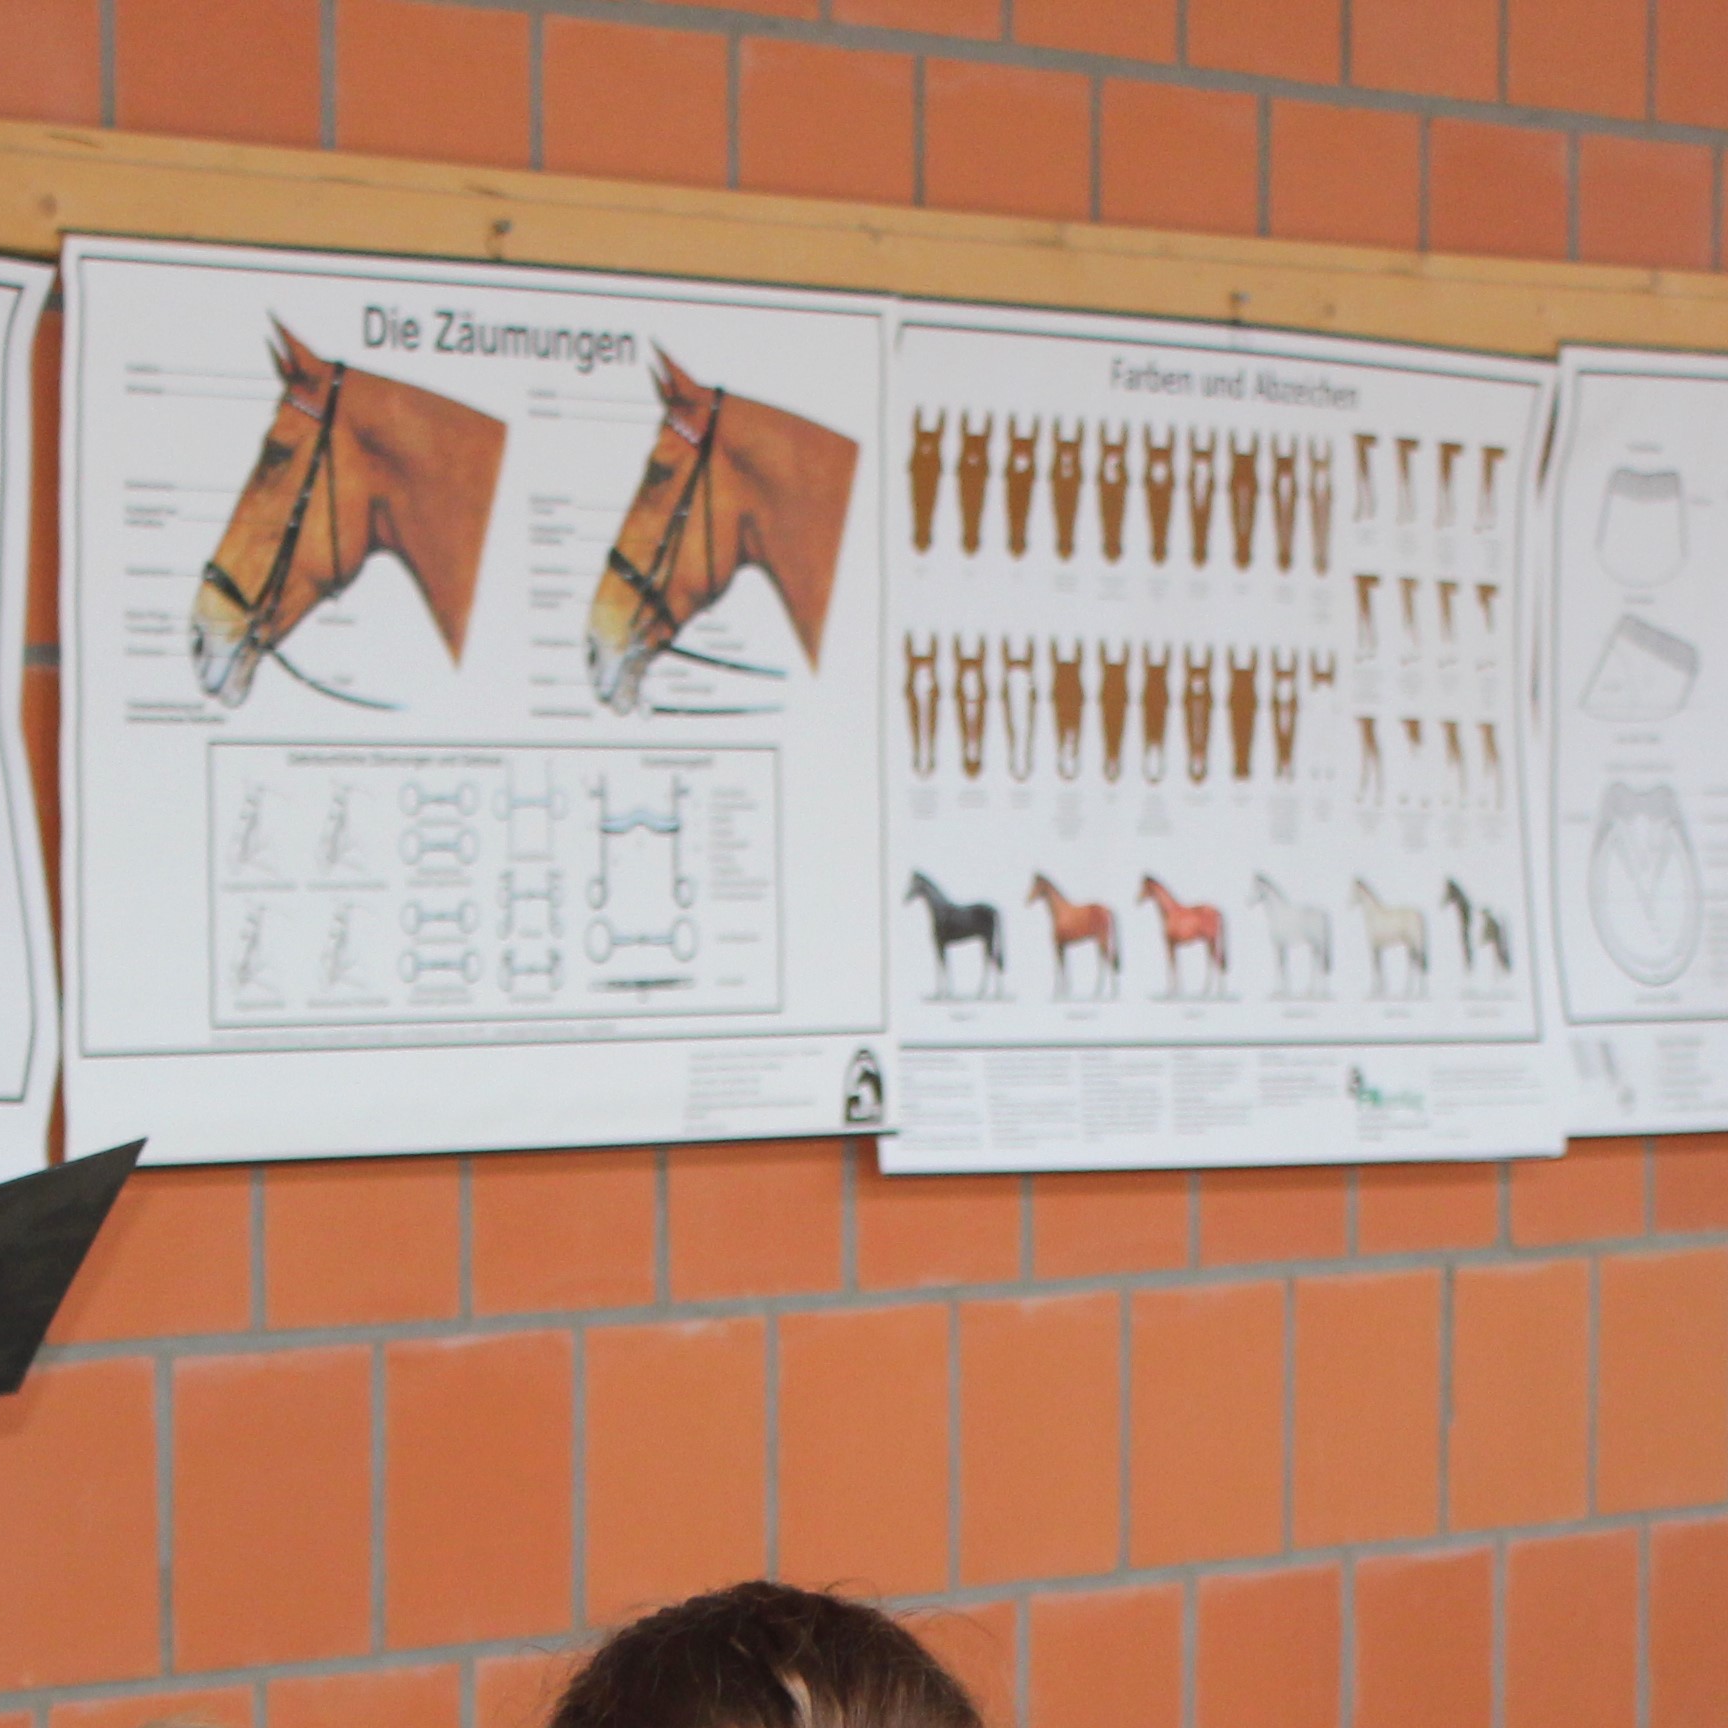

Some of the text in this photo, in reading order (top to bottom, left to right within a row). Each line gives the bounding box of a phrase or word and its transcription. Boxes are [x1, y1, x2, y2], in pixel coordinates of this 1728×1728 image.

[363, 304, 637, 373] Die Zäumungen
[1111, 356, 1358, 410] Farben und Abzeichen
